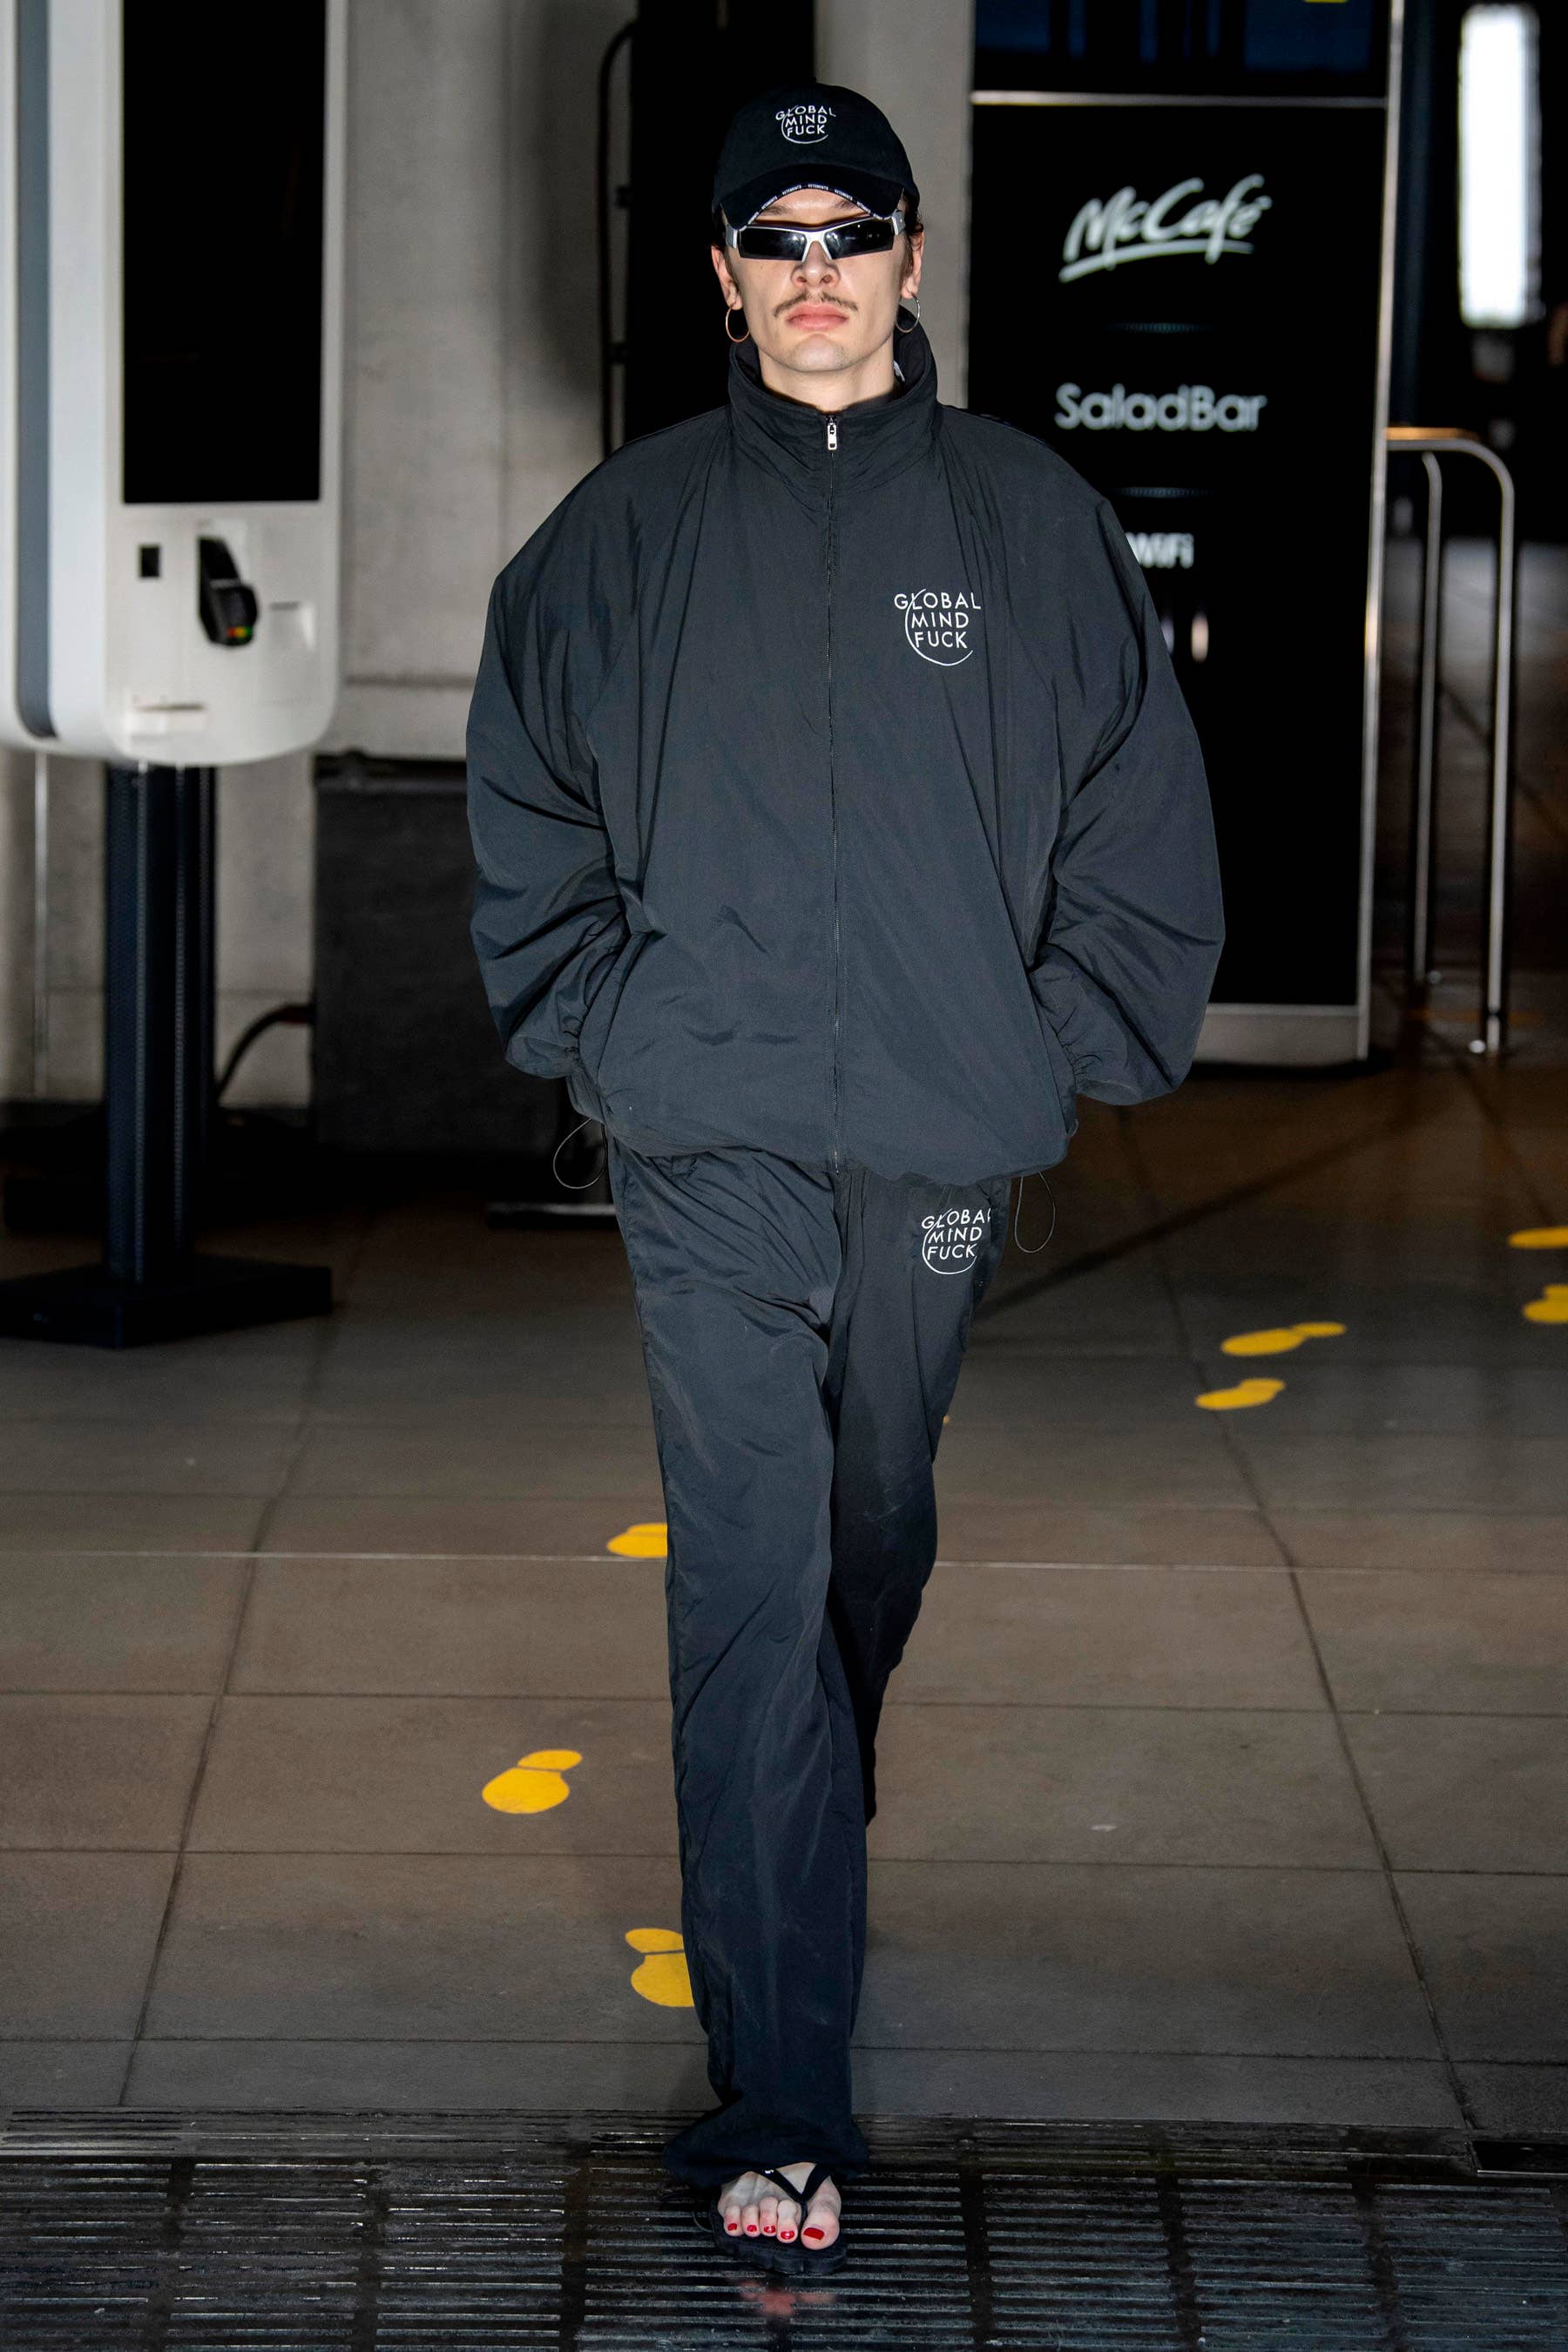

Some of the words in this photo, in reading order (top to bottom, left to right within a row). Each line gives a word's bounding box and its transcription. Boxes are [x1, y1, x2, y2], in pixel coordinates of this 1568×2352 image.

[775, 105, 836, 120] GLOBAL
[785, 114, 827, 128] MIND
[787, 125, 825, 138] FUCK
[1054, 382, 1267, 432] SaladBar
[894, 591, 982, 610] GLOBAL
[911, 612, 970, 629] MIND
[914, 630, 968, 649] FUCK
[928, 1227, 983, 1244] MIND
[927, 1243, 977, 1260] FUCK
